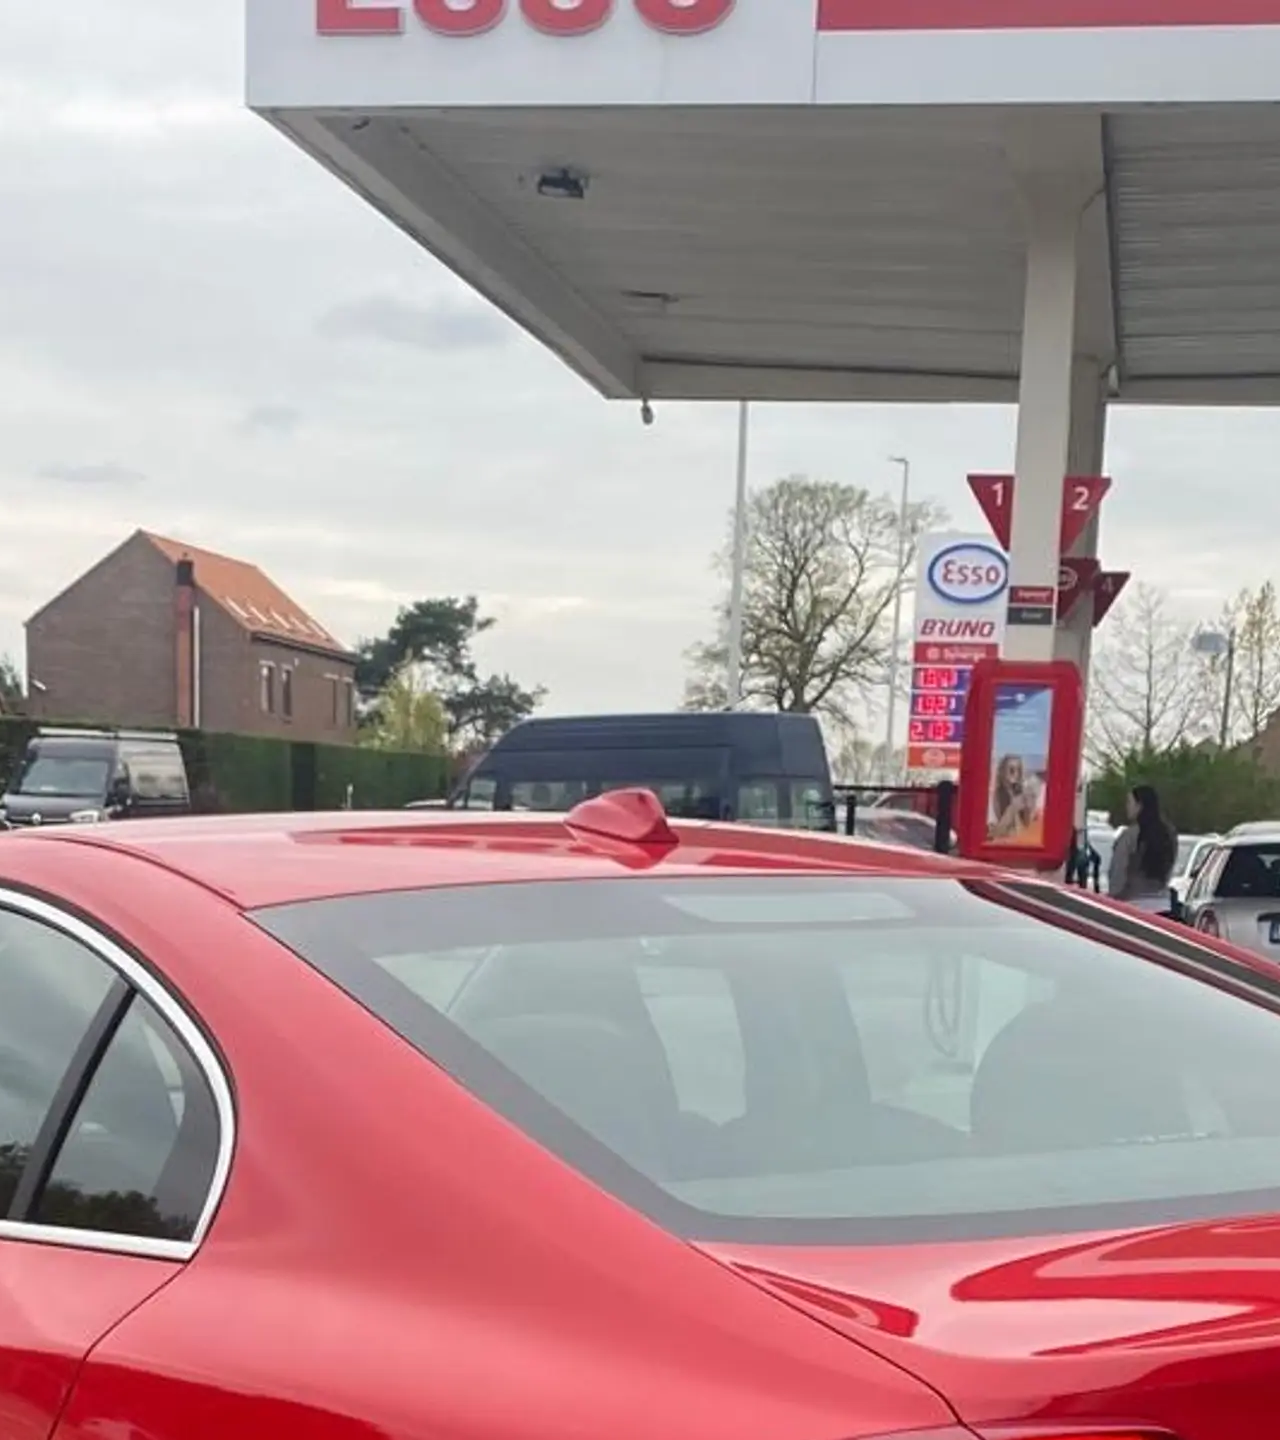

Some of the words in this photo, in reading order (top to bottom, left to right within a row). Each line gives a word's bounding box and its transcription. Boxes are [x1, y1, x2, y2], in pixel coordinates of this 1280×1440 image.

[991, 482, 1004, 506] 1
[1071, 486, 1091, 511] 2
[920, 618, 996, 638] BRUNO
